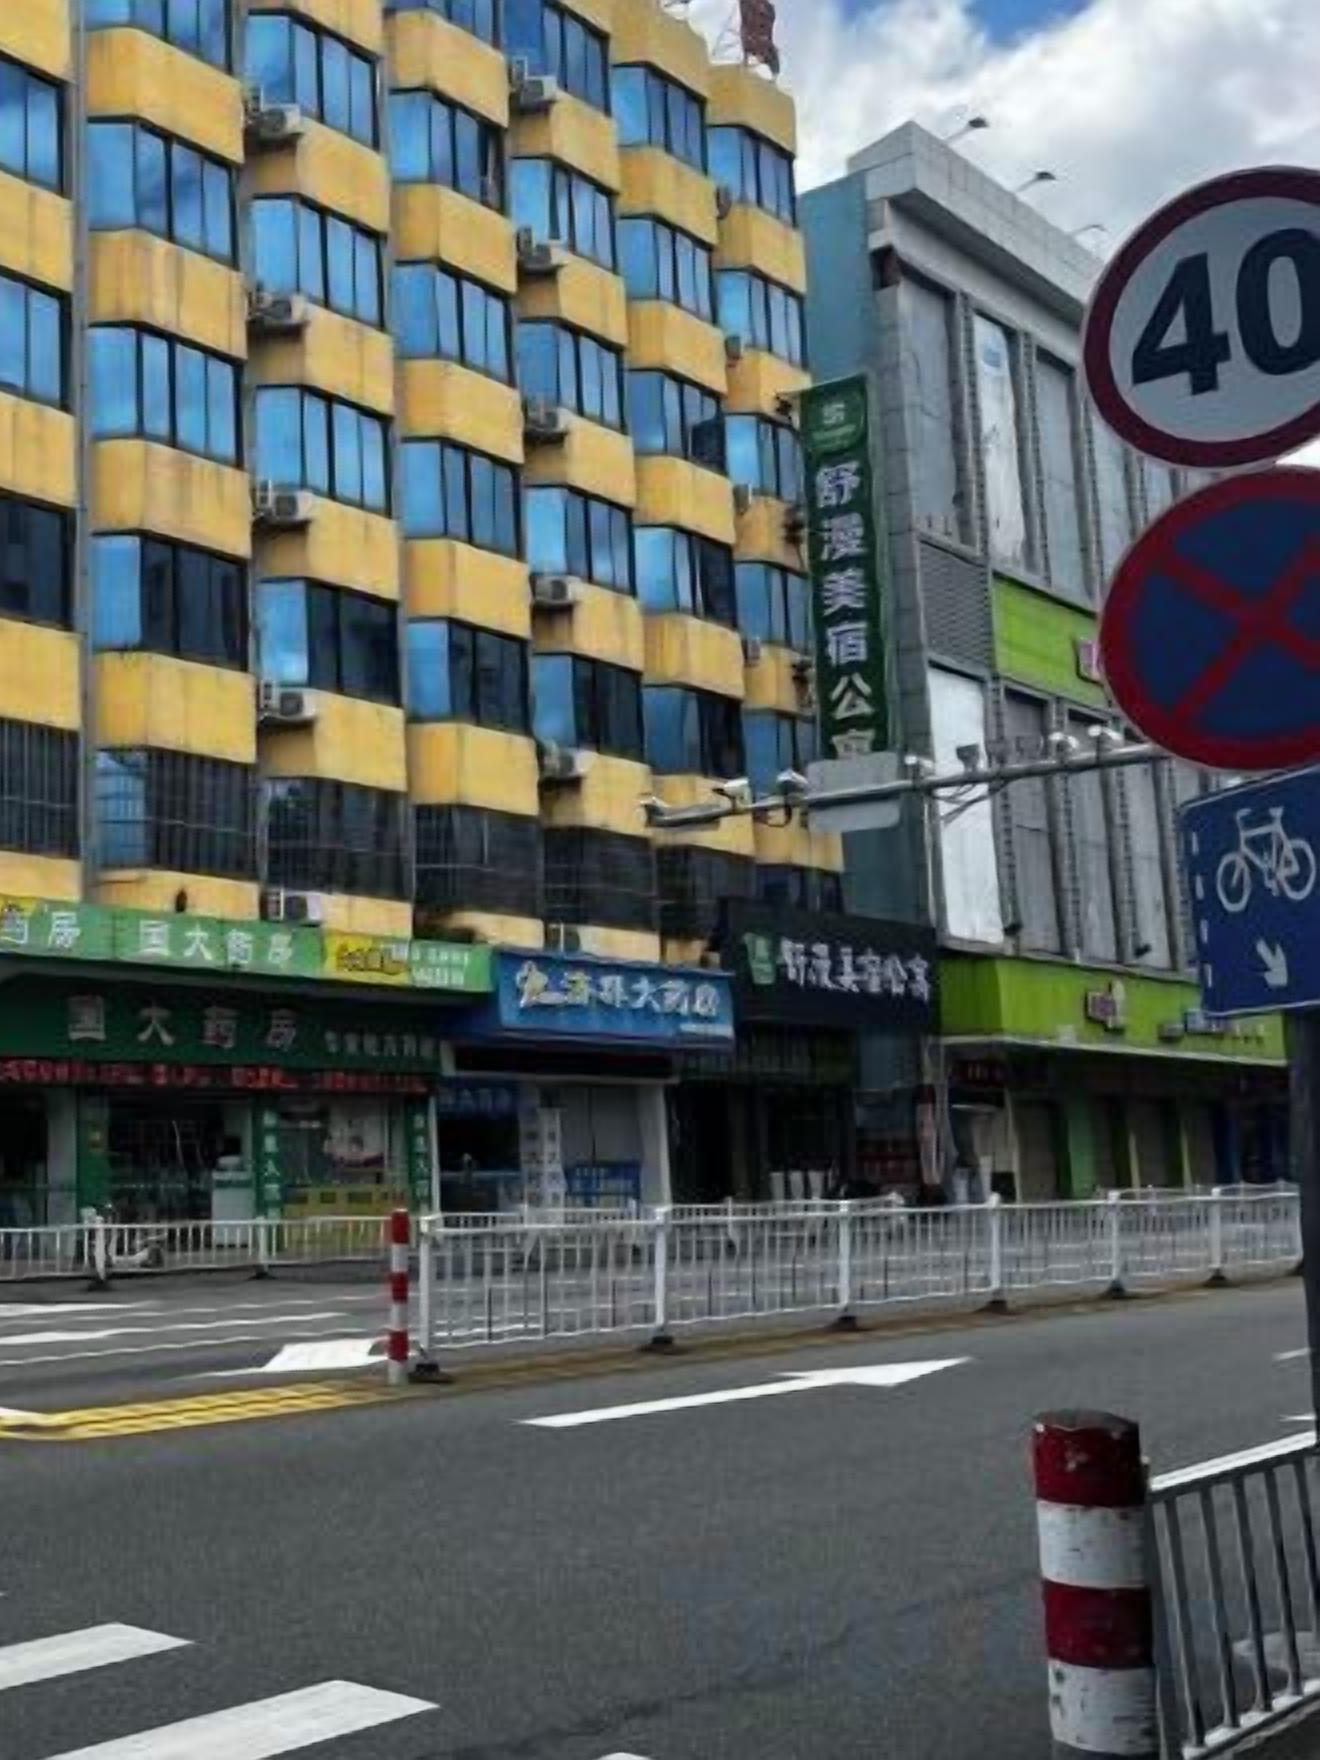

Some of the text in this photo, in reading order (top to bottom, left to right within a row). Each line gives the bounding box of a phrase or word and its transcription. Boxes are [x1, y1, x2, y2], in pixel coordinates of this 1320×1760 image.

[1132, 228, 1320, 396] 40
[139, 919, 293, 964] 国大药房
[68, 994, 299, 1051] 国大药房
